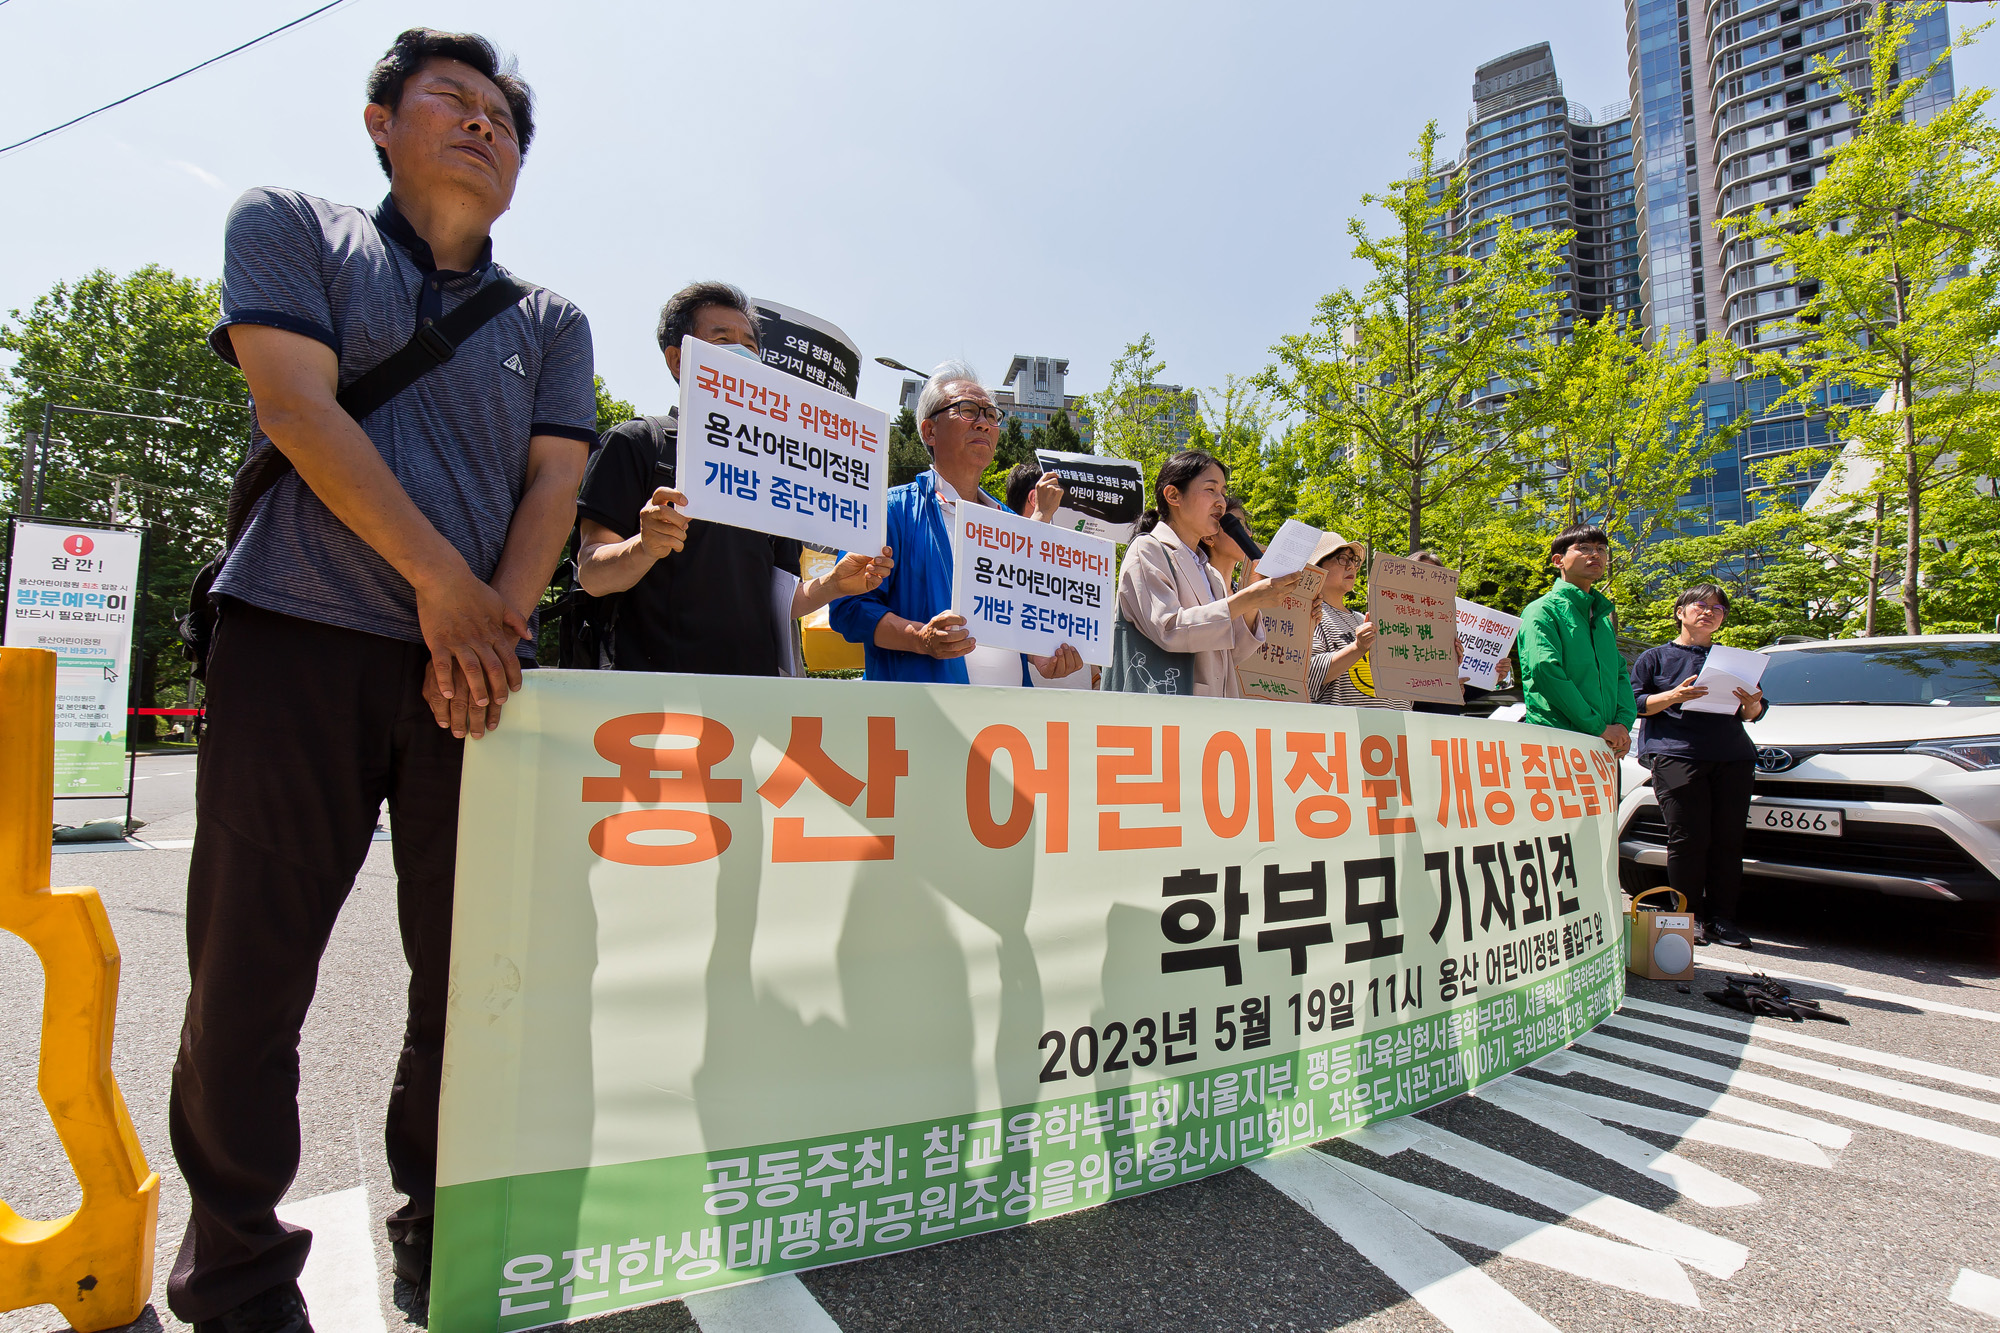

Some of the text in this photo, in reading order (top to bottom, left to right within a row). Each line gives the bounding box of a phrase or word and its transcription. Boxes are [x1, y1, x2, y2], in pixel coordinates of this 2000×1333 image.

[1474, 62, 1554, 99] ASTERIUM
[784, 335, 847, 378] 오염 정화 없는
[806, 363, 827, 385] 반환
[696, 364, 878, 453] 국민건강 위협하는
[704, 411, 870, 490] 용산어린이정원
[704, 460, 868, 530] 개방 중단하라!
[1069, 486, 1124, 504] 어린이 정원을?
[1096, 475, 1120, 488] 오염된
[1120, 479, 1136, 491] 곳에
[965, 521, 1109, 577] 어린이가 위험하다!
[17, 589, 127, 610] 방문예약이
[19, 578, 80, 589] 용산어린이정원
[974, 556, 1101, 608] 용산어린이정원
[15, 608, 126, 623] 반드시 필요합니다!
[973, 595, 1099, 642] 개방 중단하라!
[1455, 609, 1514, 640] 린이가 위험하다!
[38, 636, 101, 646] 용산어린이정원
[70, 647, 107, 655] 바로가기
[1387, 644, 1452, 662] 개방 중단하라!
[1461, 654, 1493, 676] 단하라!
[581, 711, 909, 867] 용산
[965, 721, 1418, 854] 어린이정원
[1430, 737, 1516, 829] 개방
[1520, 743, 1602, 822] 중단을
[1764, 809, 1827, 831] 6866
[1160, 833, 1581, 987] 학부모 기자회견
[1037, 1007, 1198, 1084] 2023년
[1214, 995, 1271, 1052] 5월
[1288, 979, 1355, 1036] 19일
[1368, 965, 1423, 1018] 11시
[1439, 951, 1479, 1002] 용산
[1485, 928, 1560, 986] 어린이정원
[1562, 916, 1593, 961] 출입구
[1593, 911, 1604, 946] 앞
[1329, 1035, 1510, 1127] 작은도서관고래이야기,
[1513, 1000, 1586, 1059] 국회의원강민정,
[701, 1134, 908, 1217] 공동주최:
[921, 1059, 1300, 1180] 참교육학부모회서울지부,
[1306, 992, 1521, 1091] 평등교육실현서울학부모회,
